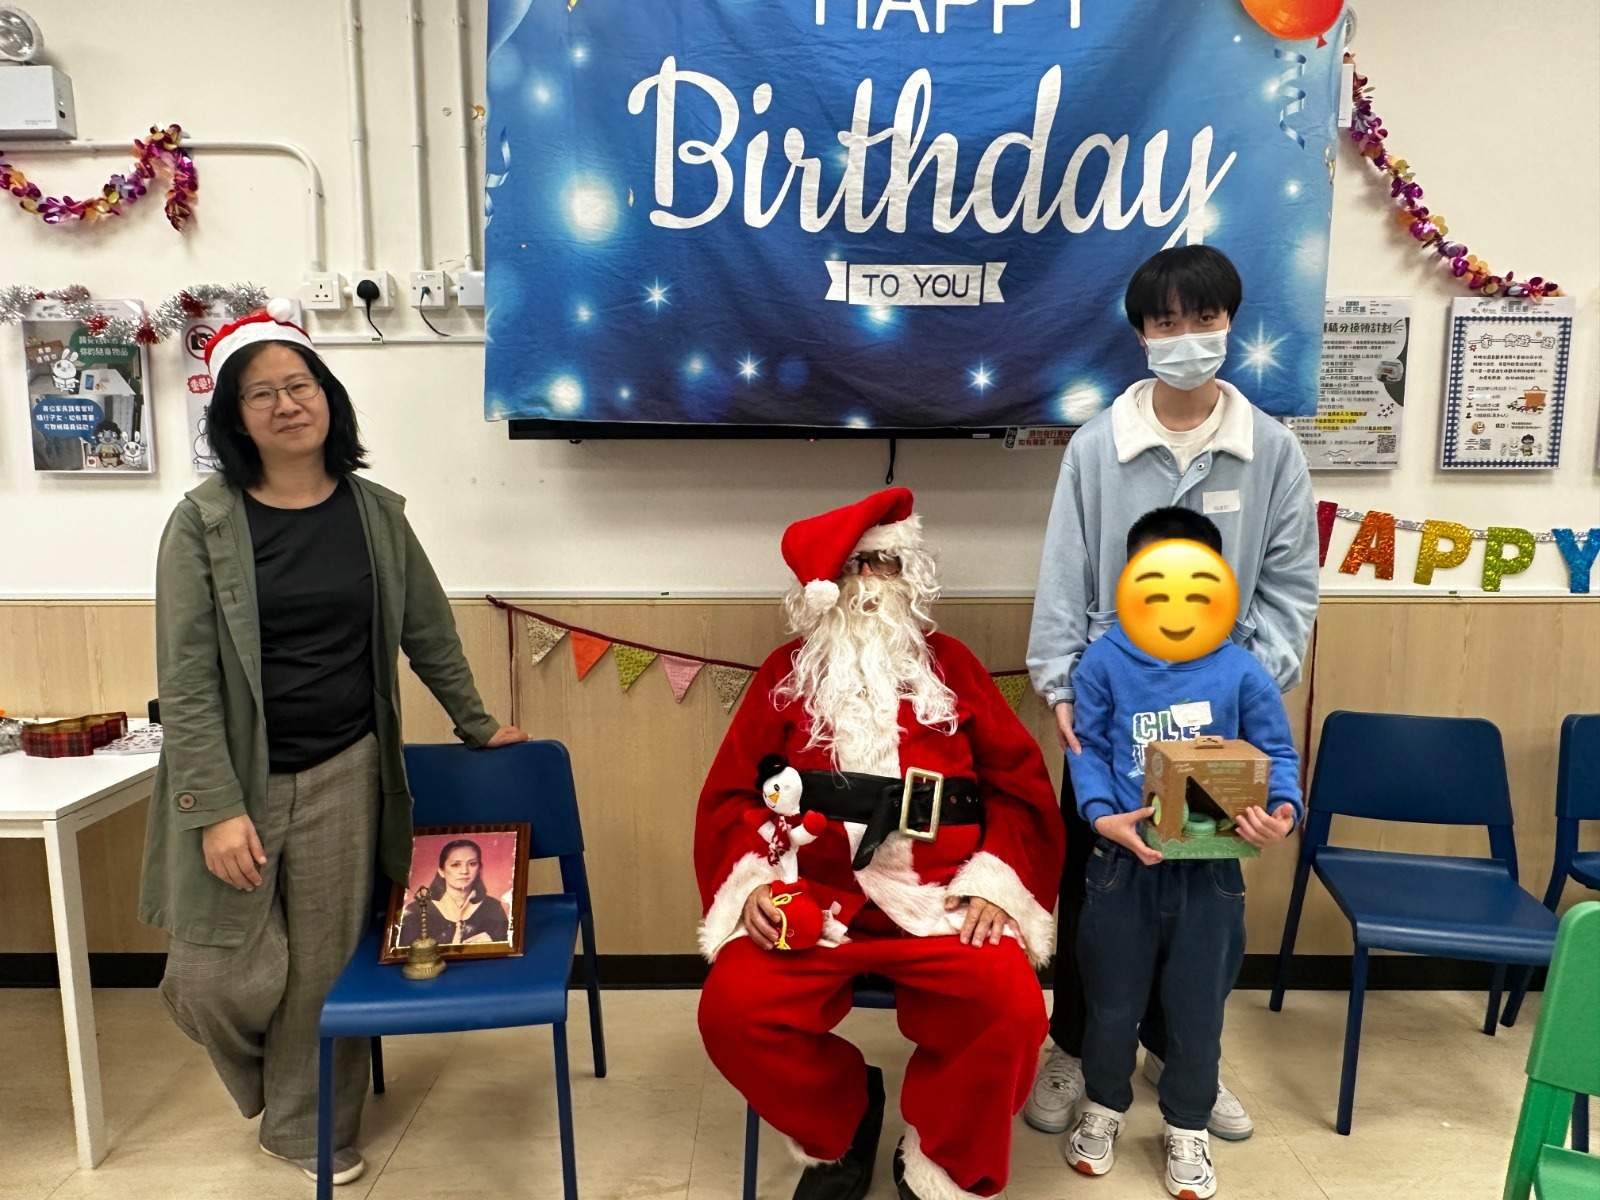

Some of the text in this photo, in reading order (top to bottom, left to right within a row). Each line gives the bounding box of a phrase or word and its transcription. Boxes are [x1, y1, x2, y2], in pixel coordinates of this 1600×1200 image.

[627, 56, 1237, 247] Birthday
[862, 273, 969, 298] TO YOU
[1323, 322, 1393, 334] 積分換領計劃
[1317, 500, 1600, 594] APPY
